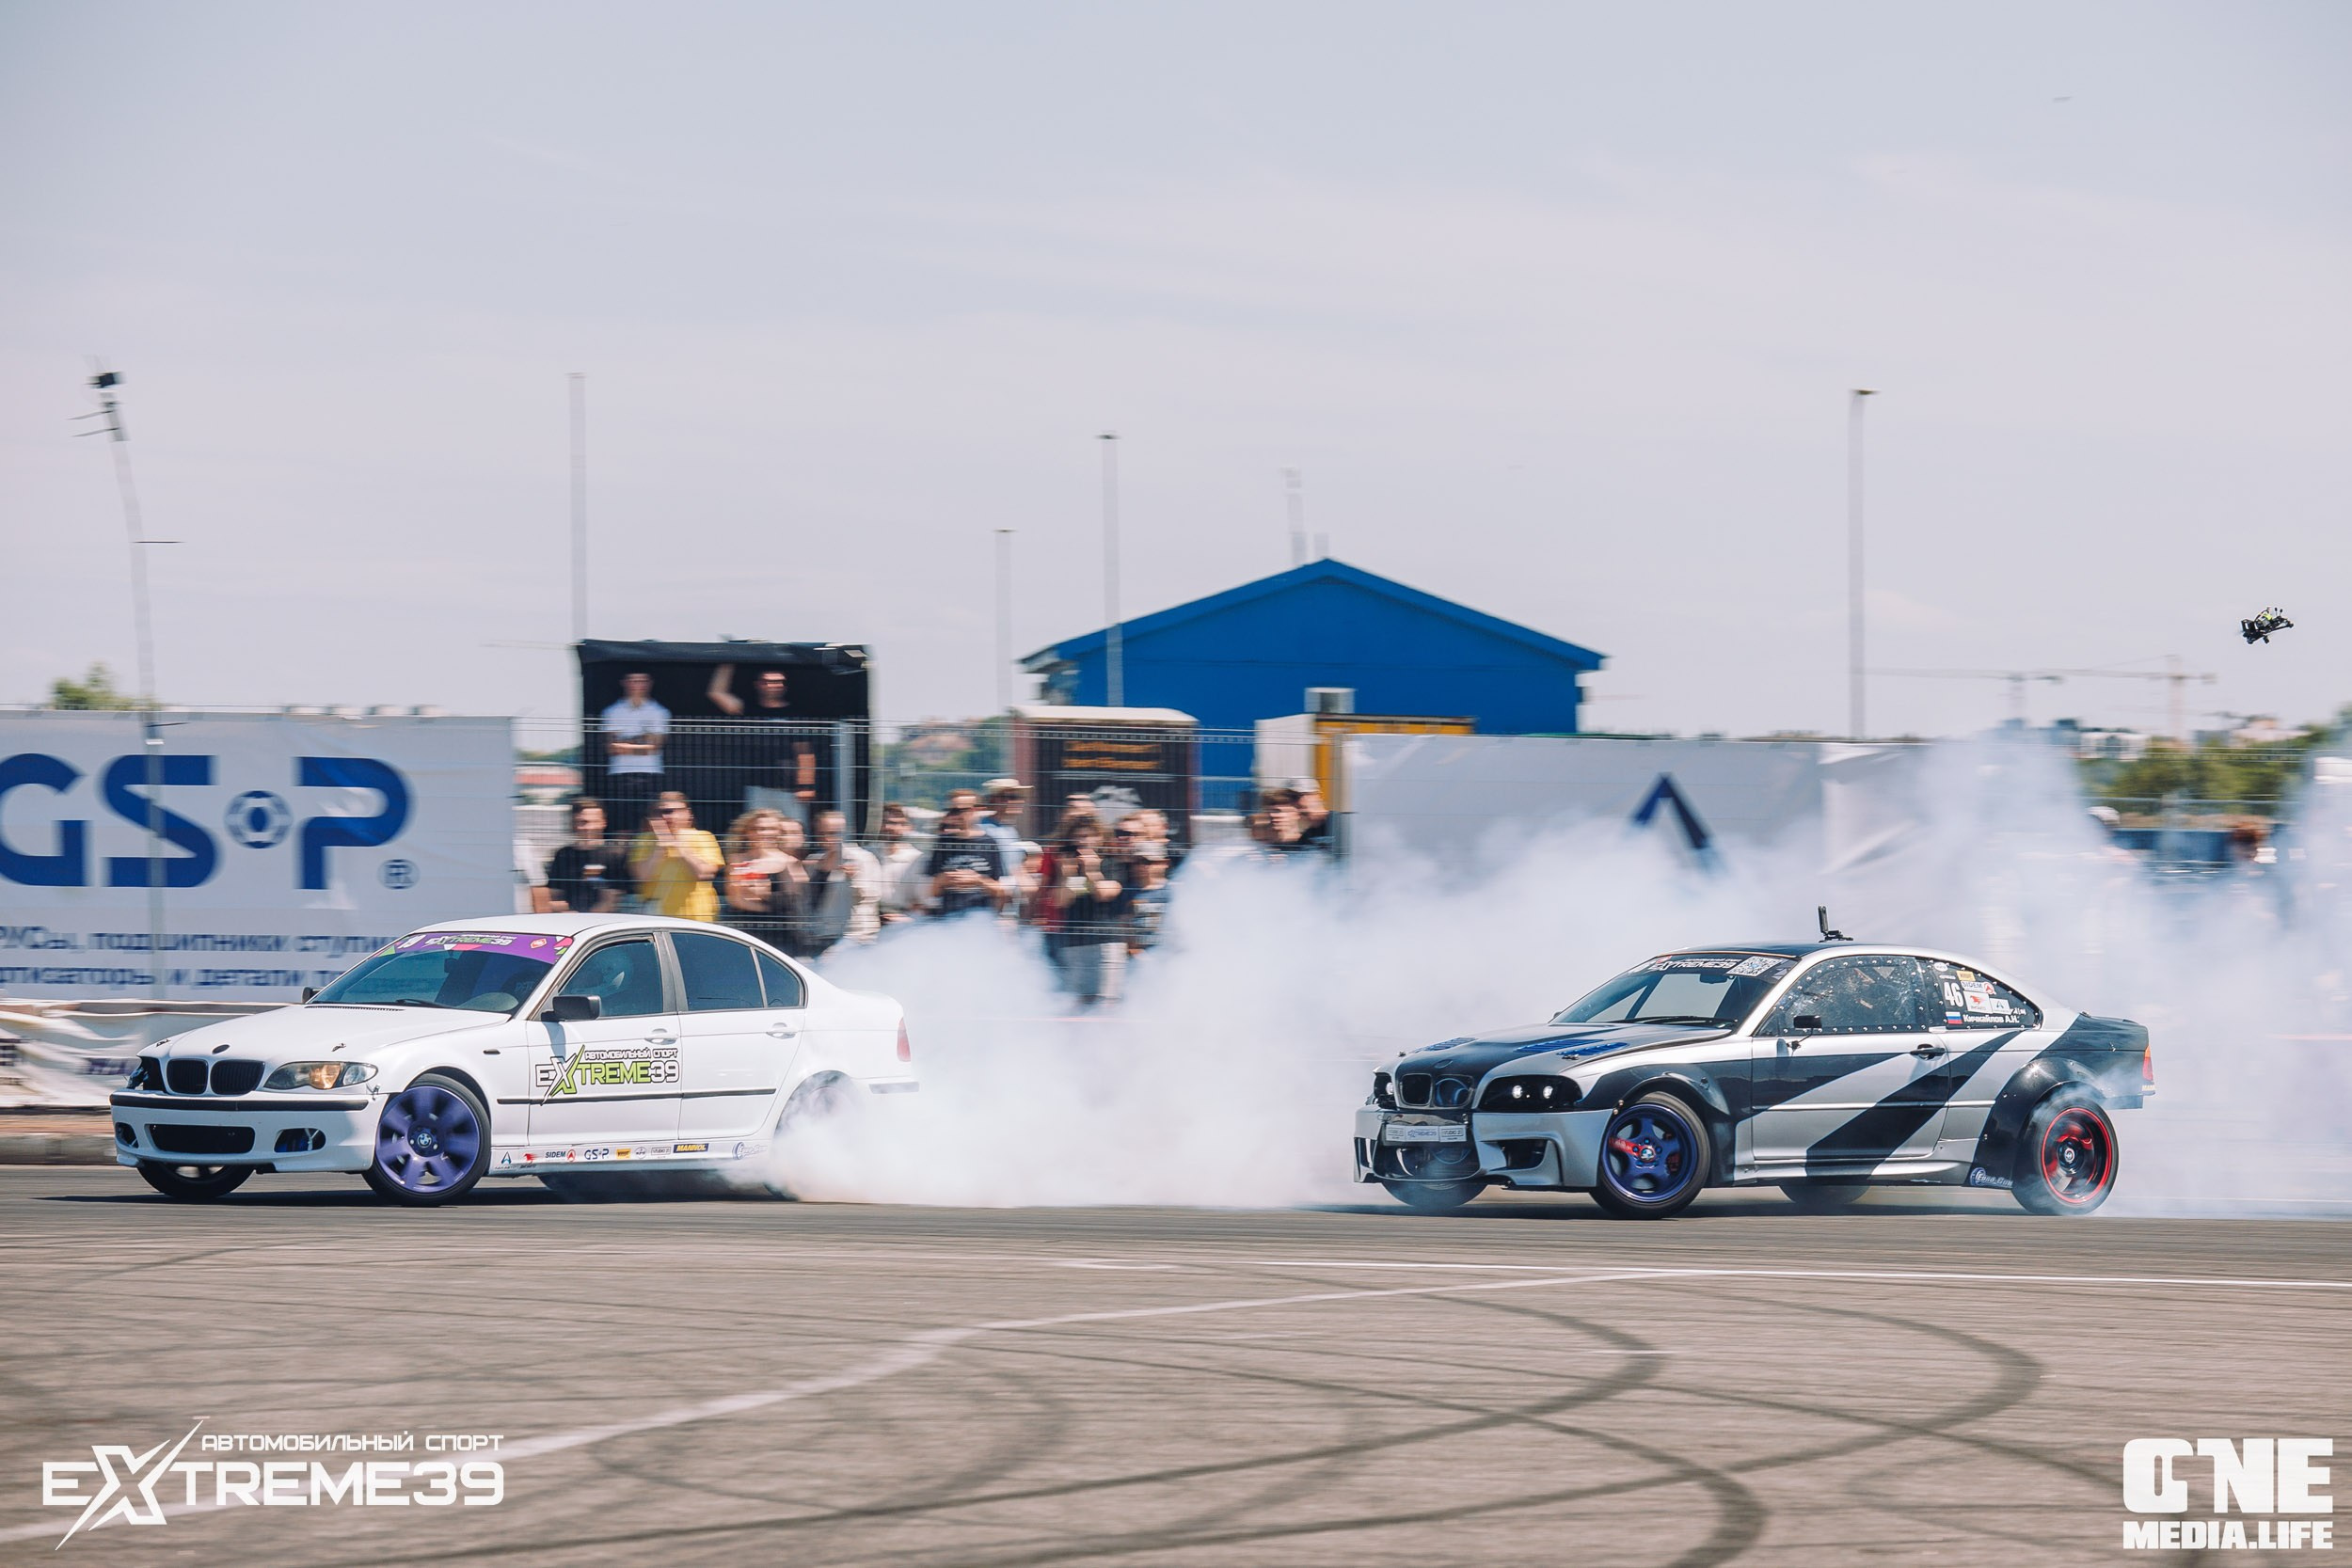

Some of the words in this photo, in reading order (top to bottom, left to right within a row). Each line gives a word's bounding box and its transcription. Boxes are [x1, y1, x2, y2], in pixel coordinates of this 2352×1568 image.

[1943, 981, 1964, 1007] 46
[584, 1047, 652, 1061] АВТОМОБИЛЬНЫЙ
[652, 1047, 678, 1060] СПОРТ
[535, 1044, 680, 1106] EXTREME39
[545, 1150, 566, 1159] SIDEM
[675, 1144, 707, 1152] MANNOL
